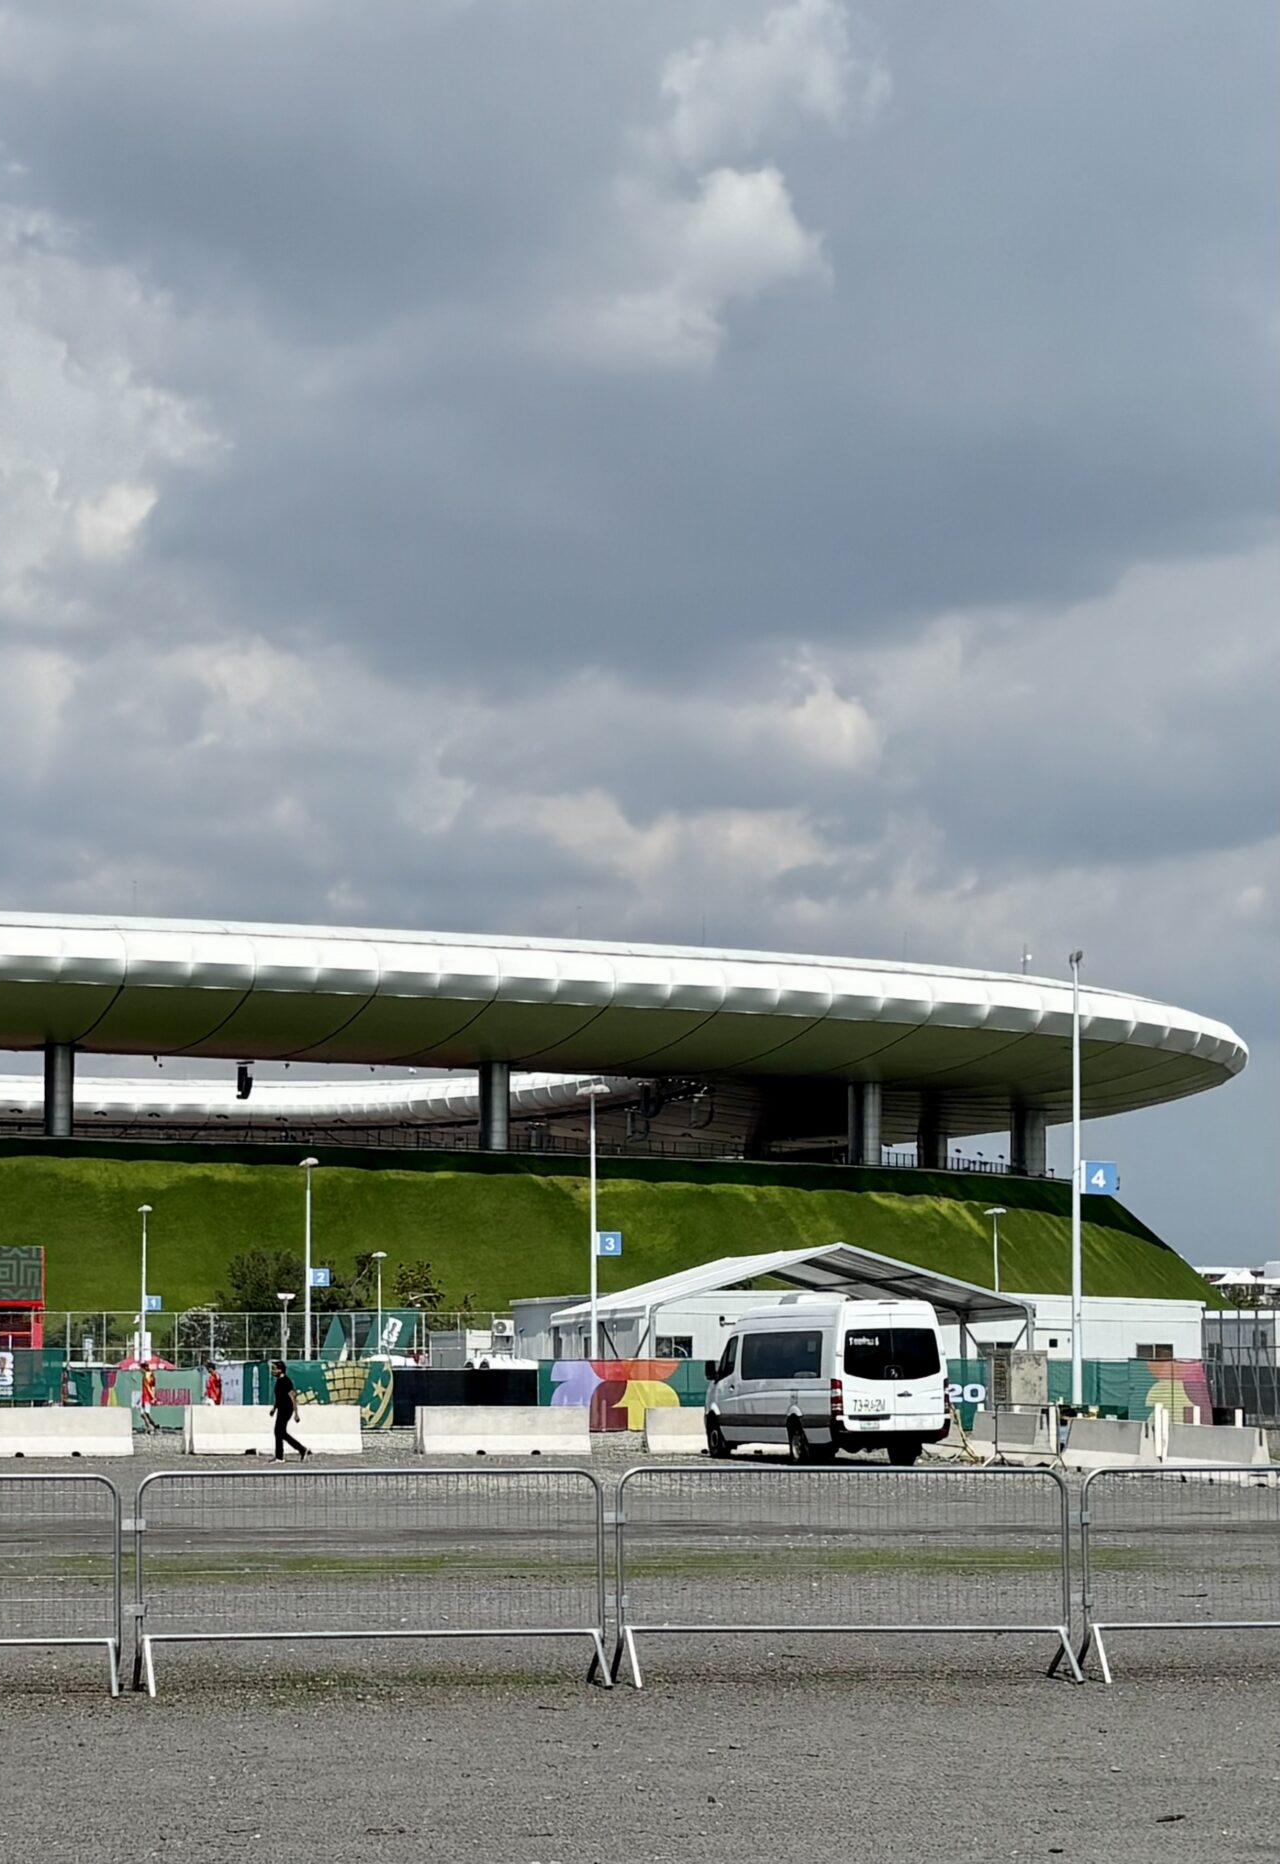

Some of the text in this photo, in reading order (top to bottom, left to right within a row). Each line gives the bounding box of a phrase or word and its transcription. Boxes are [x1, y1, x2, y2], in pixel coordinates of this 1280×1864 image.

[1091, 1169, 1106, 1188] 4
[605, 1237, 615, 1251] 3
[316, 1272, 325, 1283] 2
